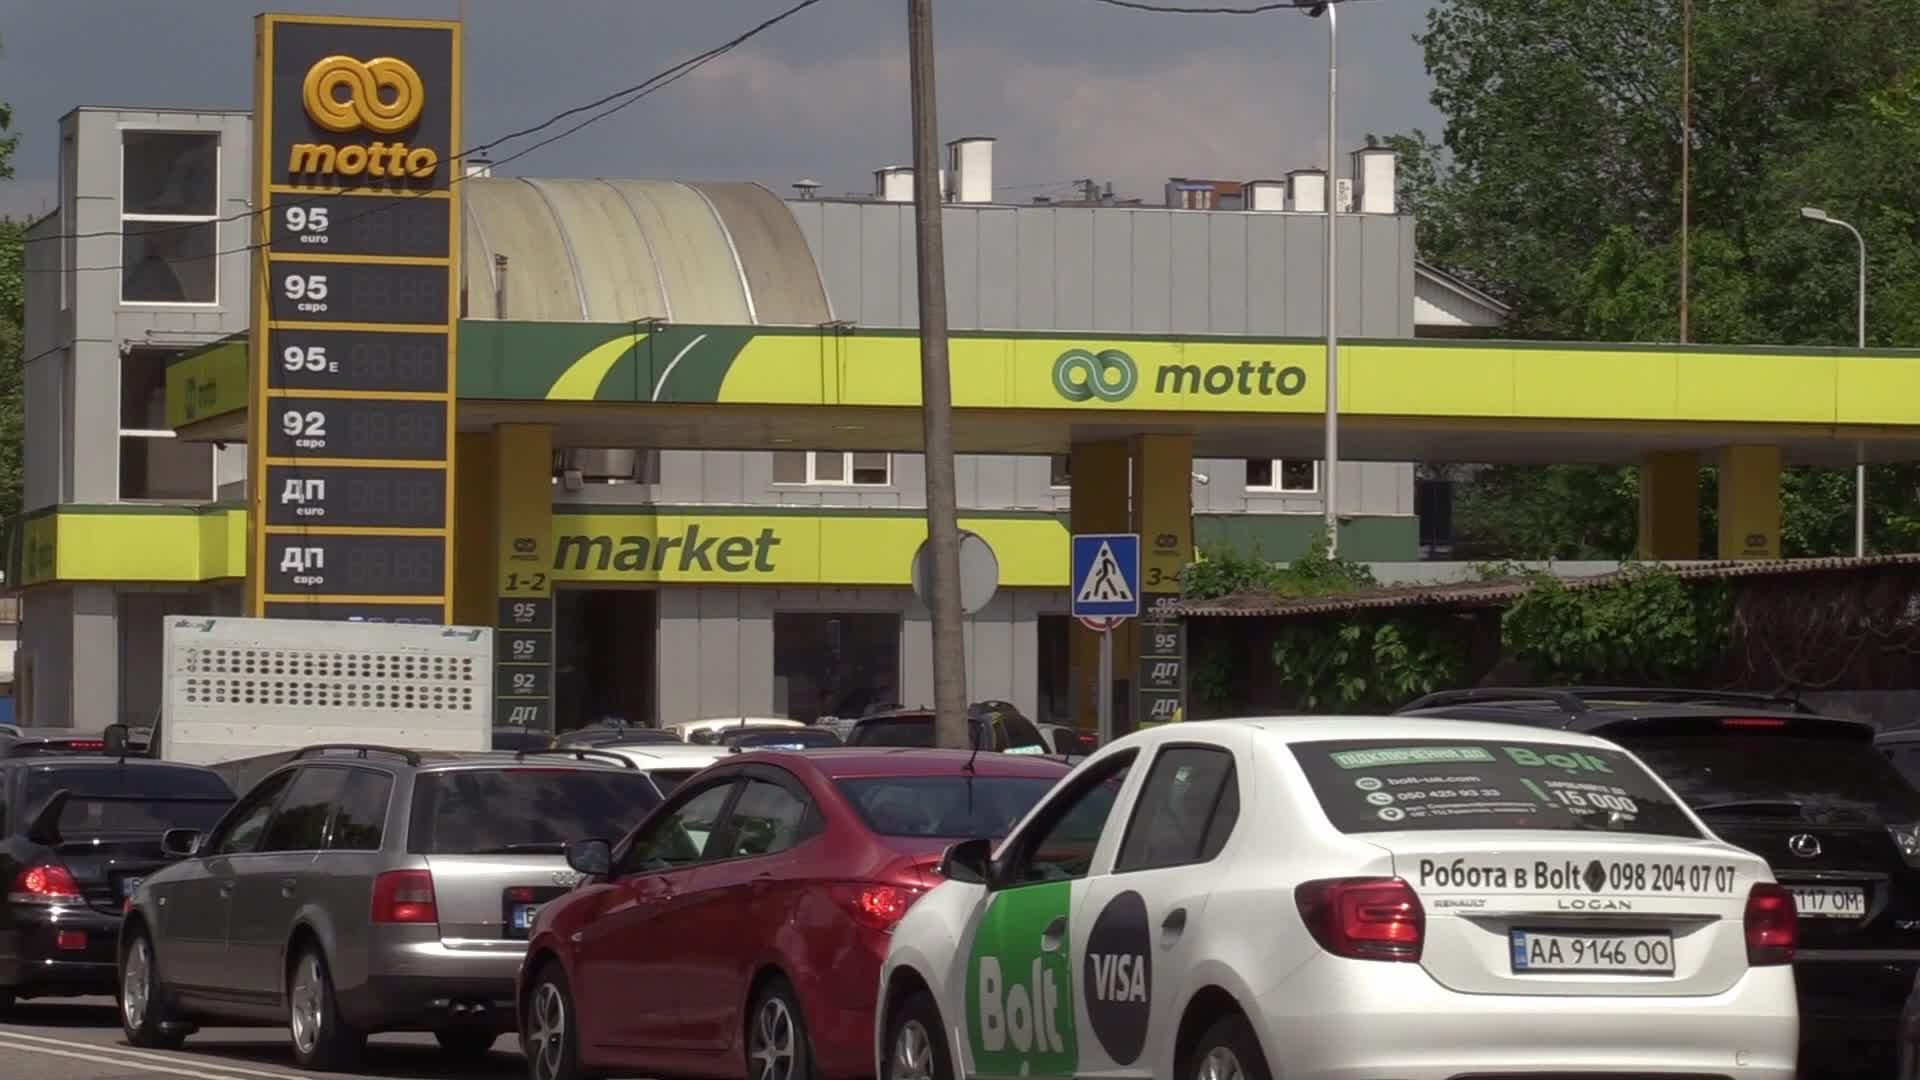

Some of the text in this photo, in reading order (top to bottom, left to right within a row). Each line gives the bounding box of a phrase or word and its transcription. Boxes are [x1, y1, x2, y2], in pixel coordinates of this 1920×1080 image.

[288, 141, 438, 178] motto
[285, 206, 329, 232] 95
[301, 234, 328, 244] euro
[284, 274, 328, 300] 95
[1155, 360, 1307, 396] motto
[282, 410, 326, 436] 92
[281, 478, 325, 505] ДП
[296, 506, 325, 516] euro
[280, 547, 324, 573] ДП
[552, 524, 782, 573] market
[504, 572, 546, 592] 1-2
[513, 603, 536, 617] 95
[513, 640, 536, 654] 95
[1155, 634, 1177, 648] 95
[513, 673, 536, 688] 92
[1152, 663, 1179, 679] ДП
[509, 706, 538, 724] ДП
[1502, 746, 1615, 774] Bolt
[1553, 790, 1588, 806] 15
[1587, 793, 1639, 813] 000
[1419, 858, 1736, 893] Робота в Bolt 098 204 07 07
[1558, 900, 1632, 910] LOGAN
[1530, 938, 1564, 964] AA
[1571, 939, 1627, 965] 9146
[1090, 953, 1147, 1003] VISA
[979, 955, 1064, 1053] Bolt
